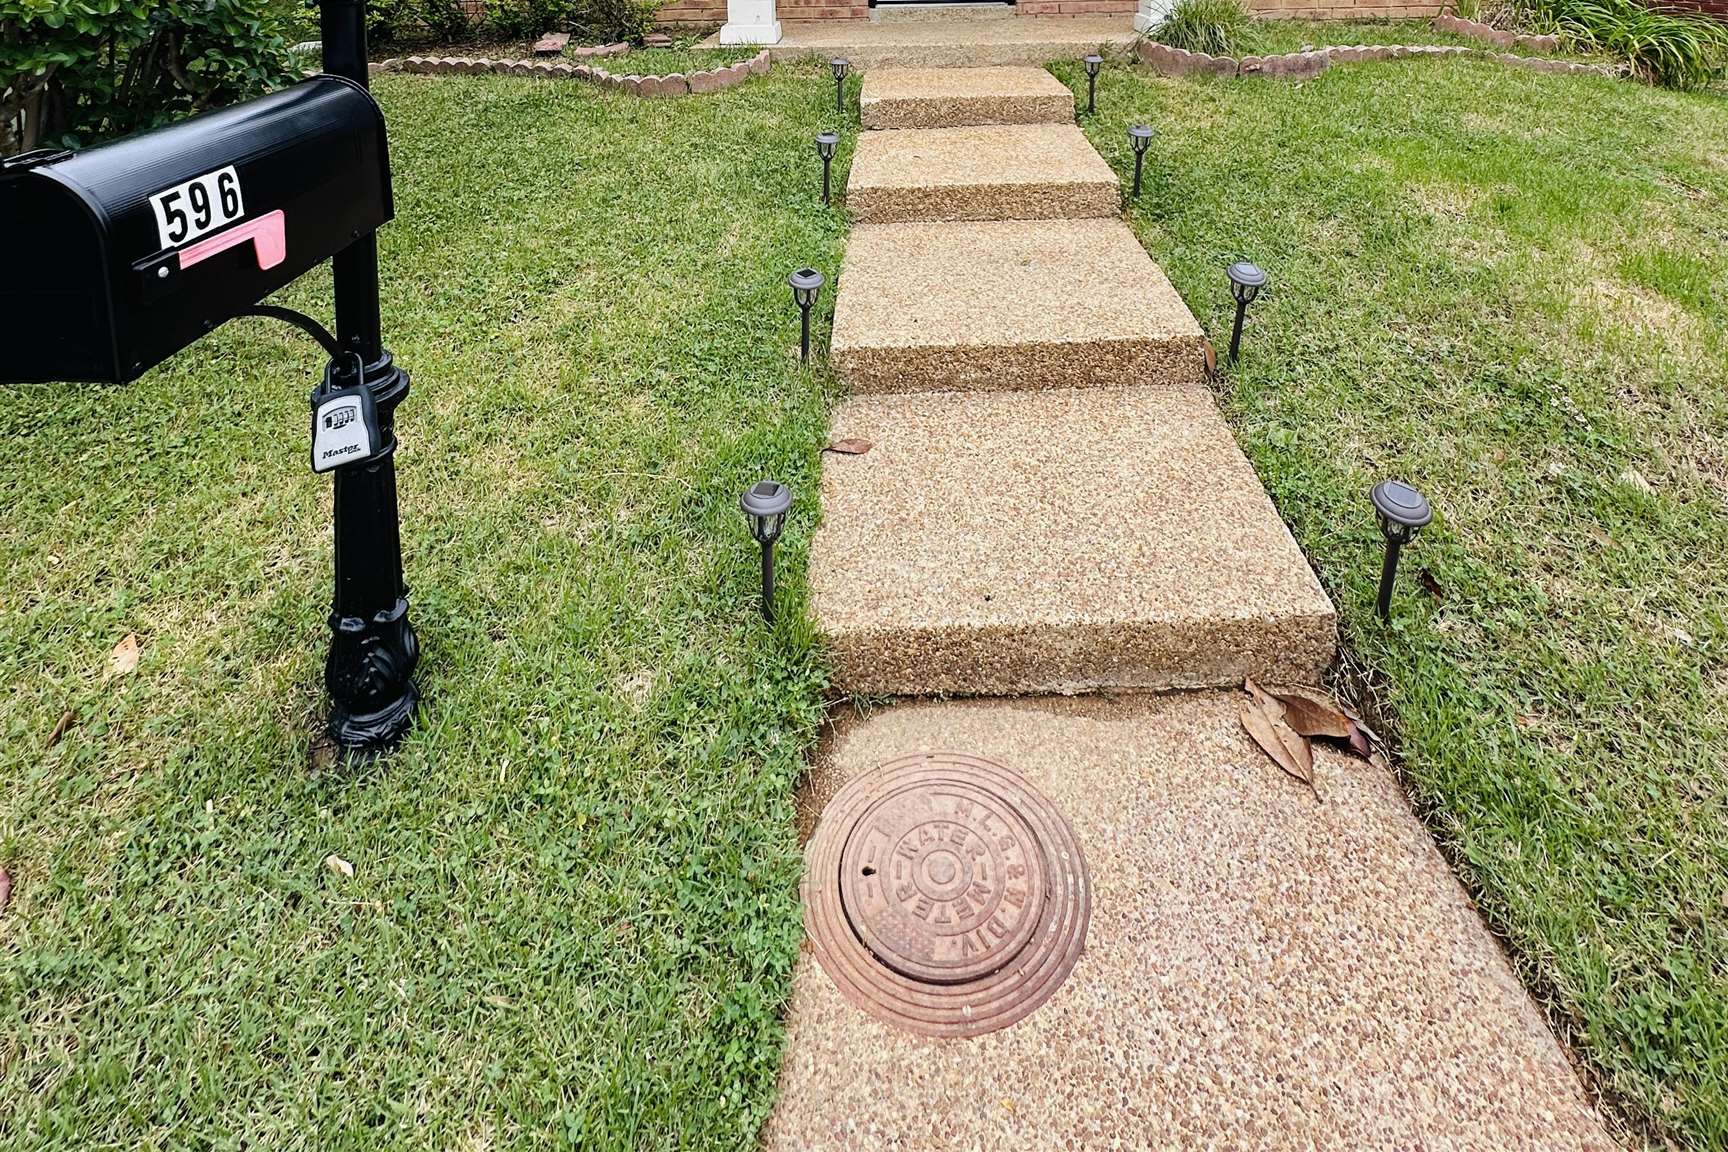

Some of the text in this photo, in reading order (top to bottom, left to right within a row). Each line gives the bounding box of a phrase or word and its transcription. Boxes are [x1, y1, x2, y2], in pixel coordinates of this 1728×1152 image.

[159, 172, 239, 243] 596
[322, 444, 359, 459] Master
[896, 823, 986, 862] WATER
[895, 880, 992, 924] METER
